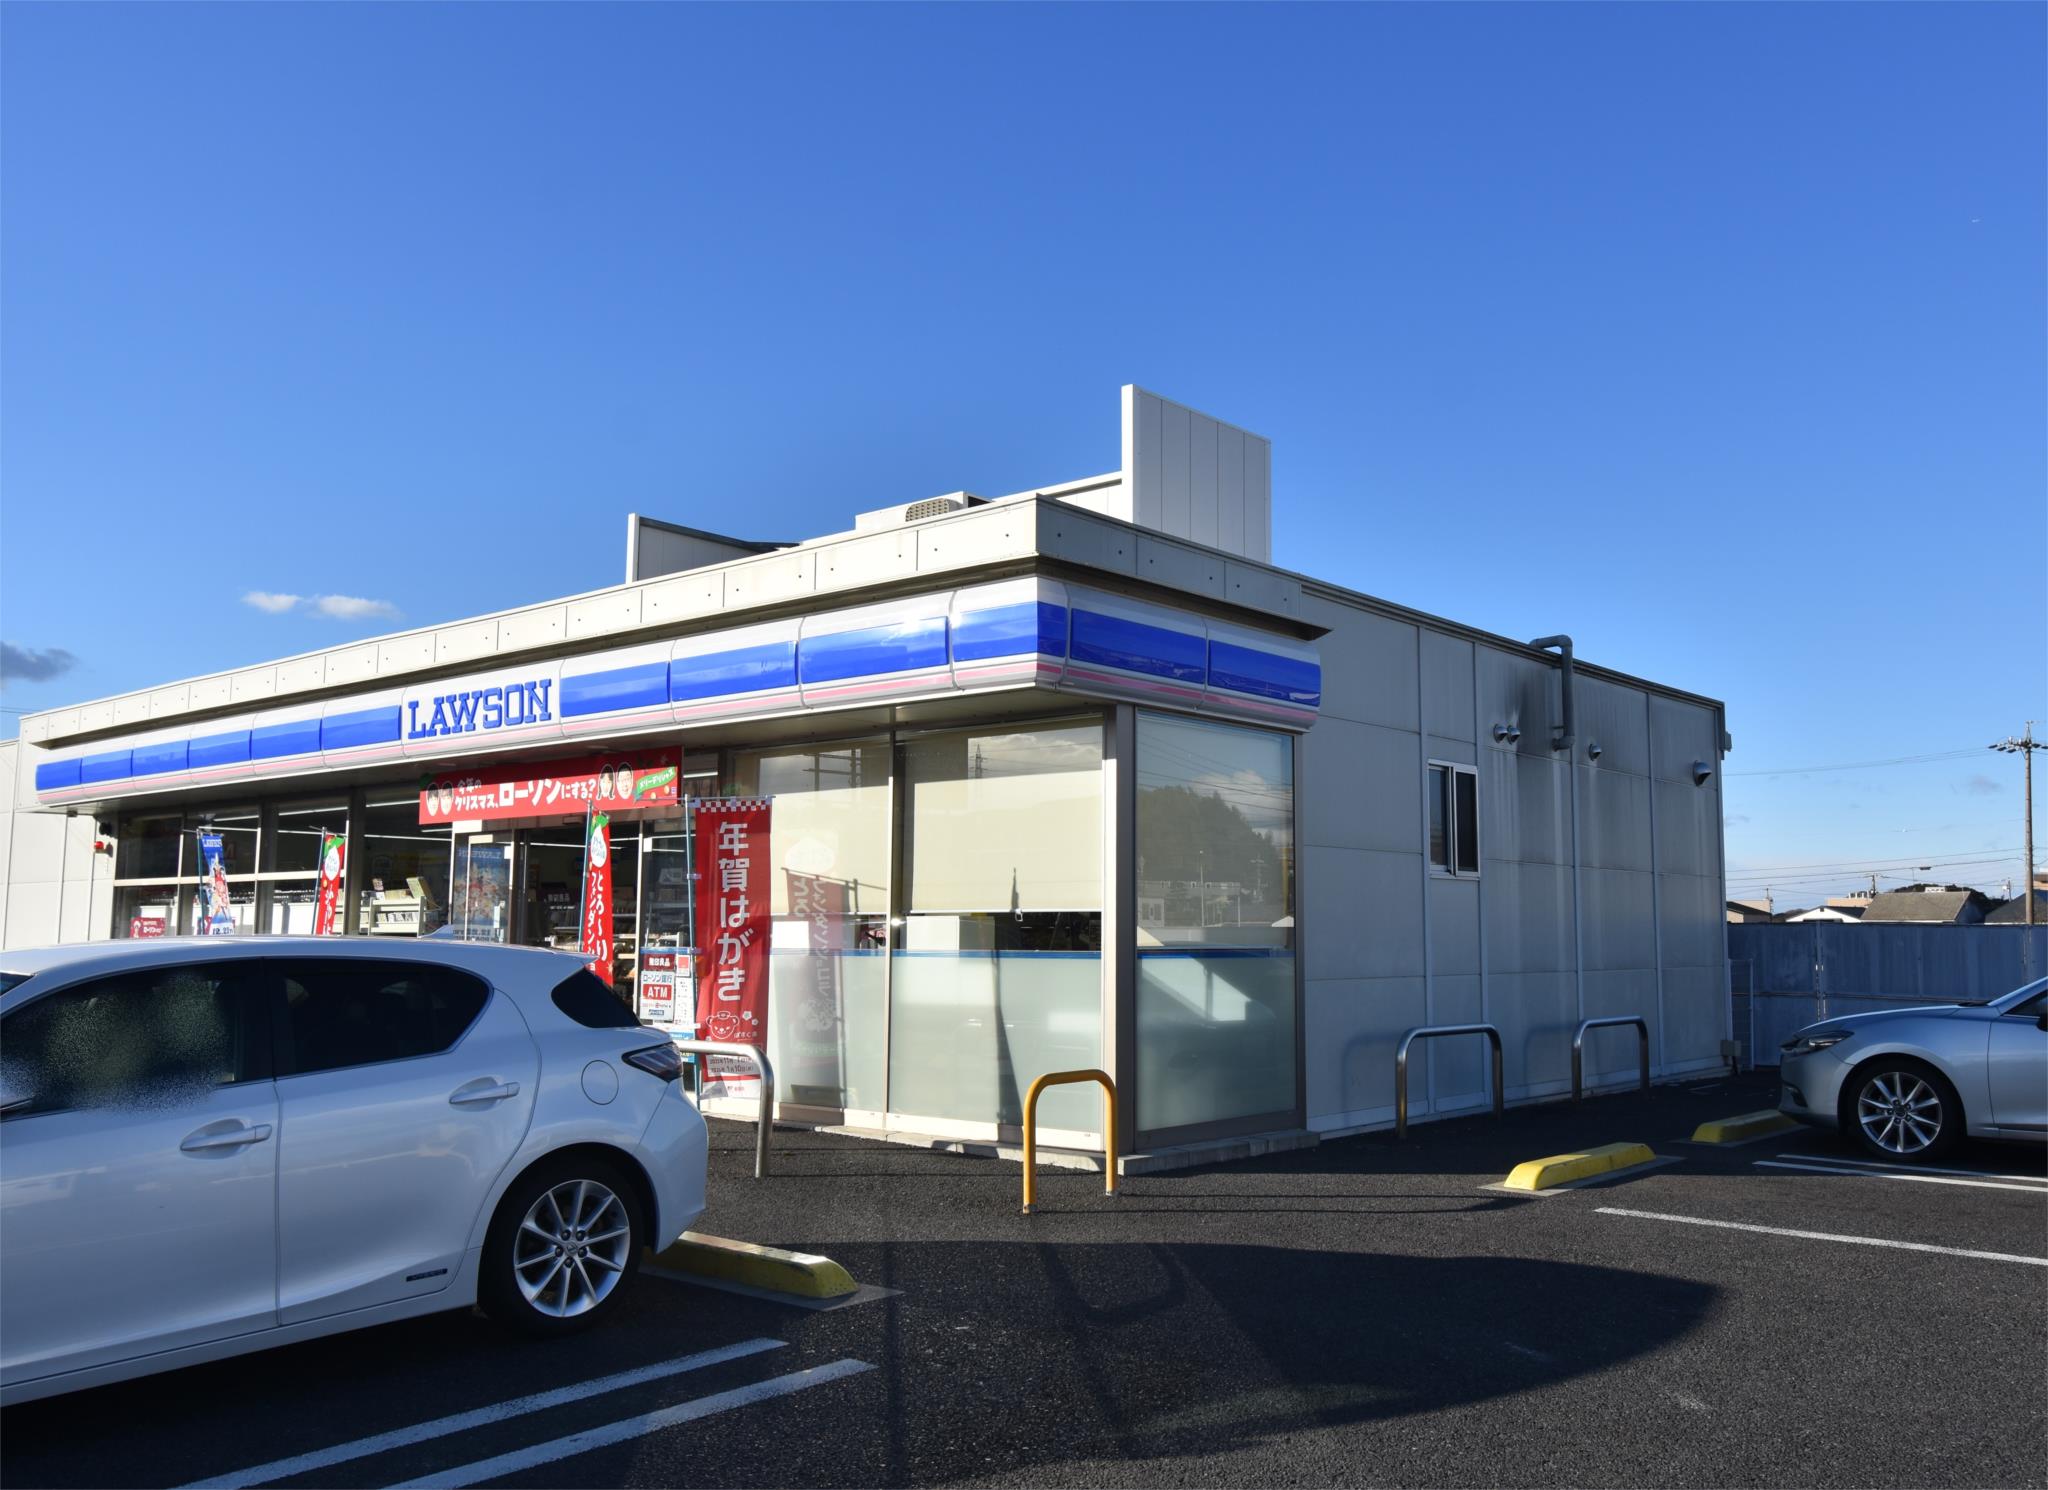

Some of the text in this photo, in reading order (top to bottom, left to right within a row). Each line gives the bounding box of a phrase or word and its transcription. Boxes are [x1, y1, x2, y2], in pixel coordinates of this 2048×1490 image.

[408, 678, 553, 740] LAWSON
[457, 777, 482, 794] 今年の
[716, 821, 754, 1002] 年賀はがき
[643, 974, 673, 984] ローソン銀行
[647, 987, 668, 998] ATM
